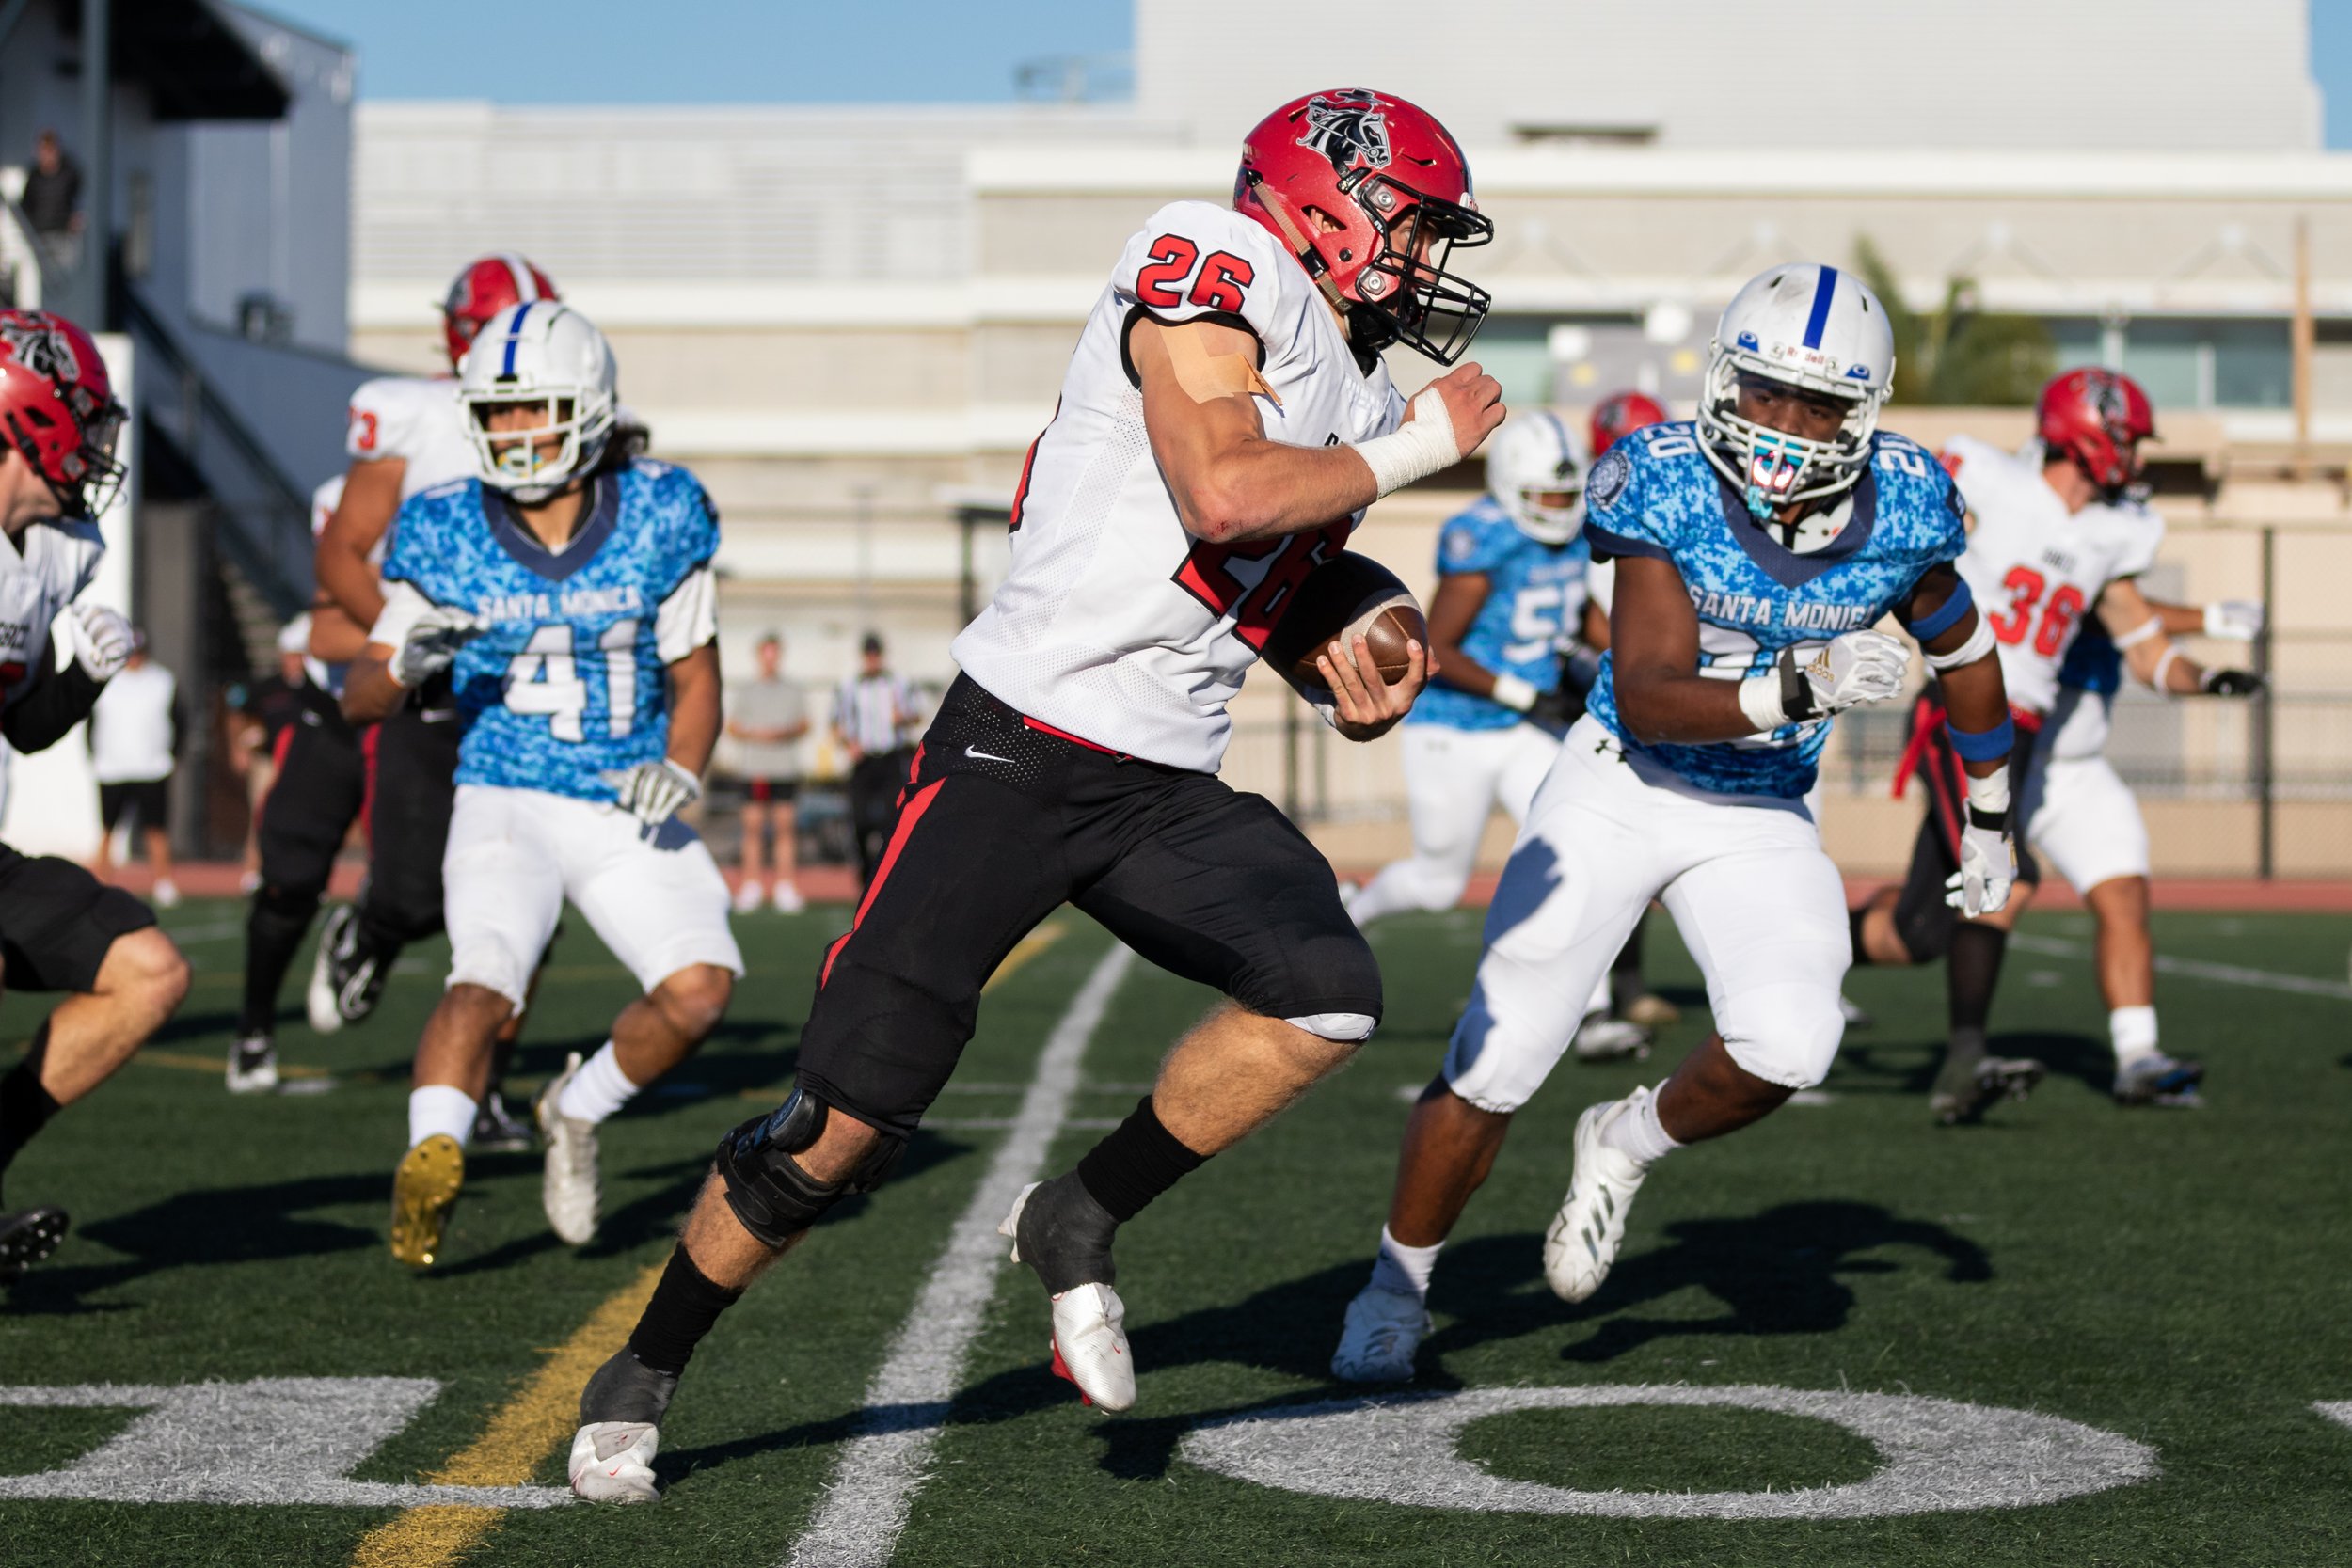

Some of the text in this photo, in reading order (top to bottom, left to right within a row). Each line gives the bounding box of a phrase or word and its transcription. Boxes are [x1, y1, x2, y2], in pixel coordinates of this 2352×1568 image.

[1136, 232, 1256, 314] 26
[1642, 423, 1699, 459] 20
[477, 584, 643, 621] SANTA MONICA
[1689, 584, 1771, 626] SANTA
[1988, 565, 2085, 658] 36
[503, 619, 640, 744] 41
